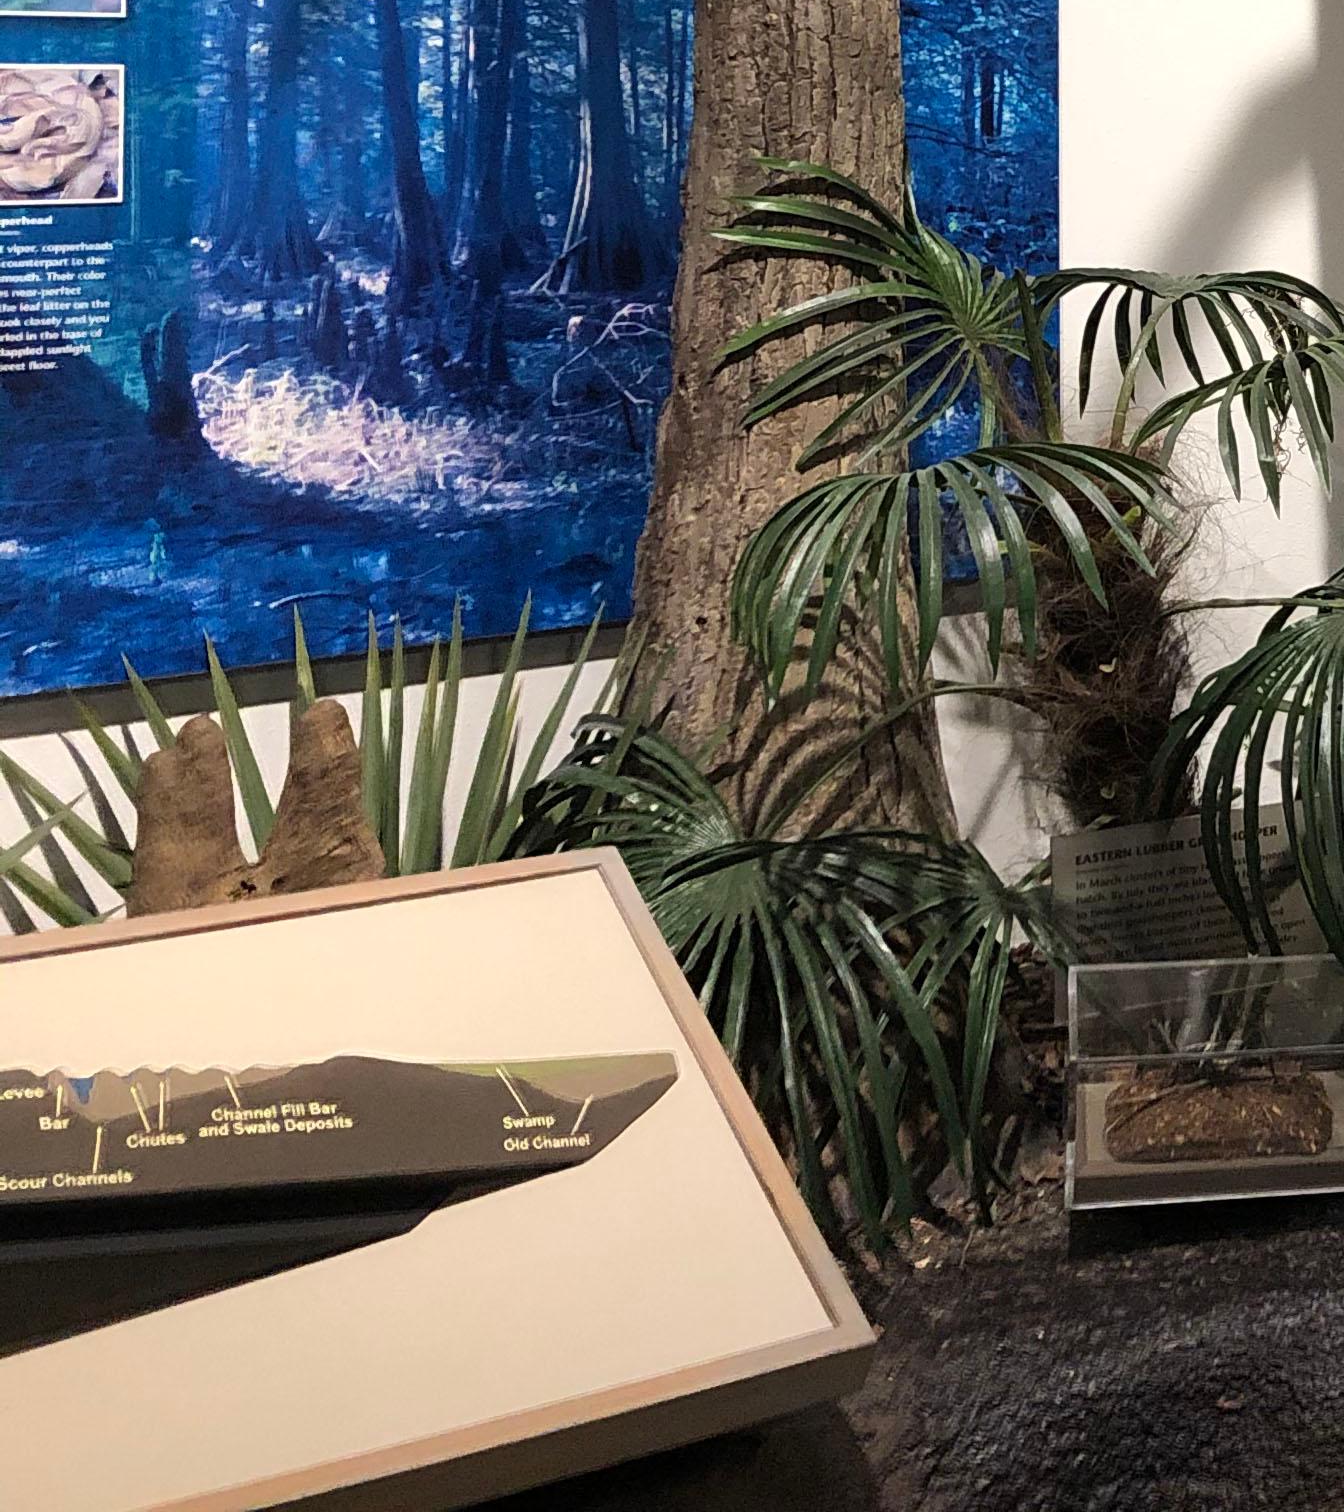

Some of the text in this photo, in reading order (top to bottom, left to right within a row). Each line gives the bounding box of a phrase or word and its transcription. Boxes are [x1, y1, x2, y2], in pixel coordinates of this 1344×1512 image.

[0, 215, 53, 228] perhead
[1074, 848, 1132, 866] EASTERN
[1135, 840, 1184, 857] LUBBER
[211, 1102, 338, 1122] Channel Fill Bar
[39, 1116, 70, 1131] Bar
[198, 1123, 230, 1138] and
[284, 1116, 353, 1134] Deposits
[502, 1115, 556, 1129] Swamp
[126, 1133, 188, 1149] Chutes
[503, 1133, 591, 1151] Old Channel
[0, 1168, 134, 1192] Scour Channels
